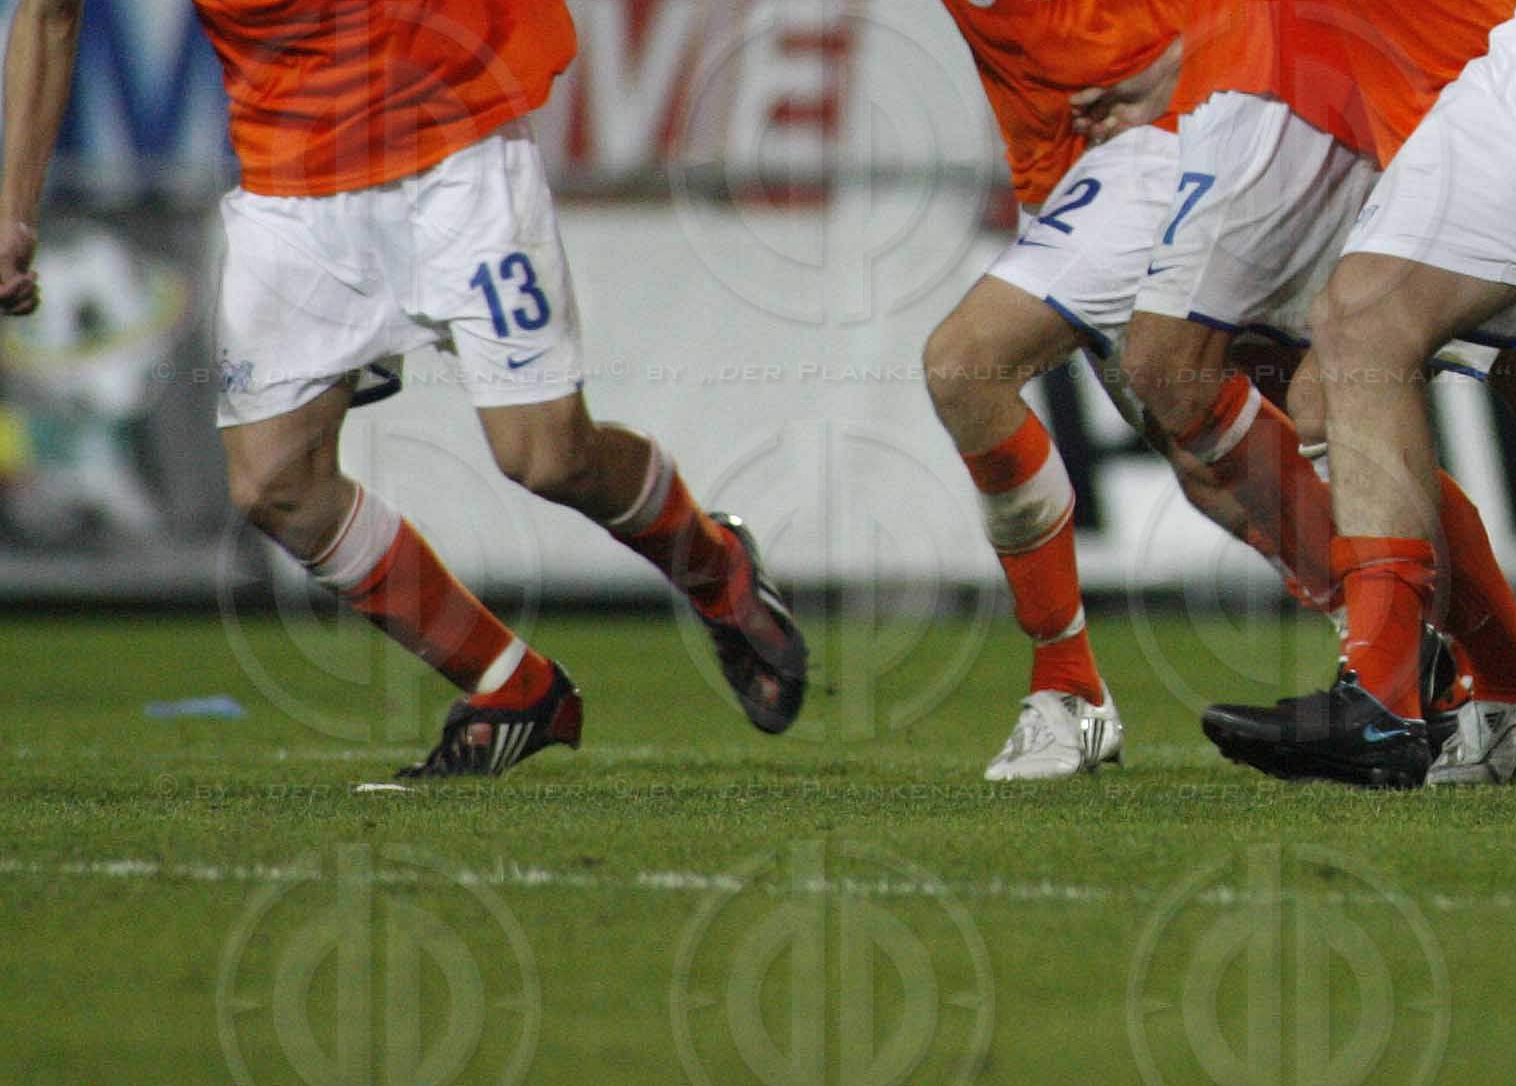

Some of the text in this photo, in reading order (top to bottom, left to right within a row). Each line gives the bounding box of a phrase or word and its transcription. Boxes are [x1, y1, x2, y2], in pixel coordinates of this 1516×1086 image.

[1038, 178, 1102, 234] 2
[1163, 172, 1215, 244] 7
[470, 252, 550, 338] 13
